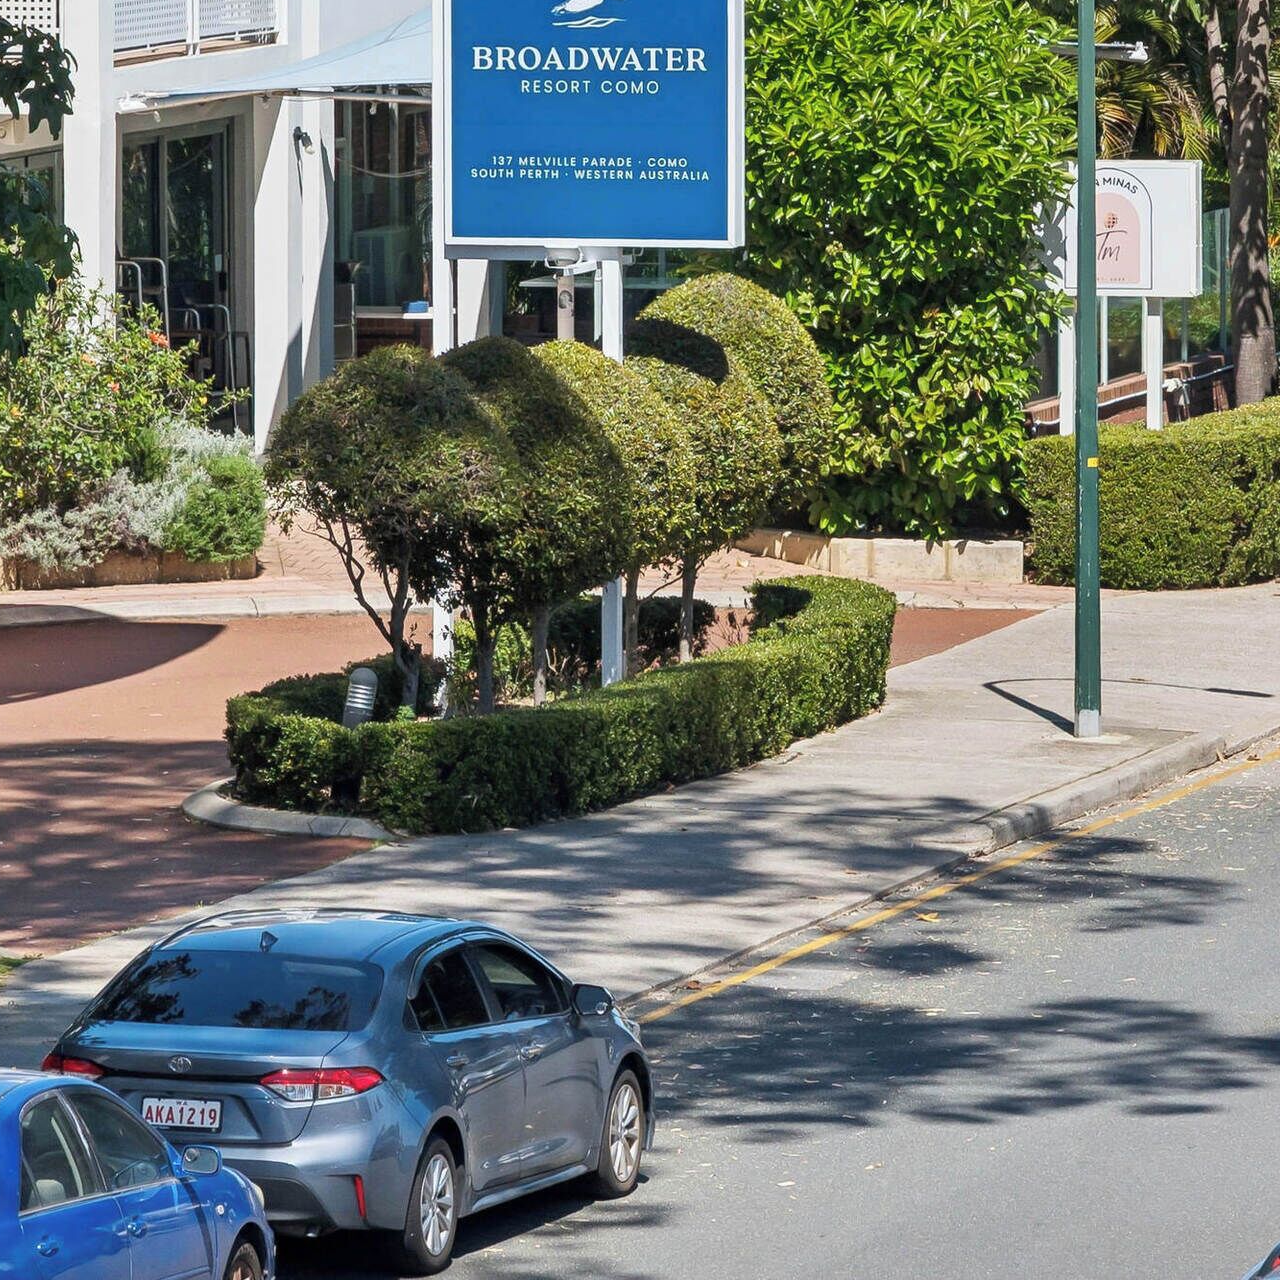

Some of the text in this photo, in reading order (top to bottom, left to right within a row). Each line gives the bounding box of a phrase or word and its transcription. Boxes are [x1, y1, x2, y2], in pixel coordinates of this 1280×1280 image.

[471, 45, 708, 72] BROADWATER
[521, 79, 659, 95] RESORT COMO
[491, 155, 688, 168] 137 MELVILLE PARADE COMO
[470, 168, 710, 181] SOUTH PERTH WESTERN AUSTRALIA
[1102, 177, 1138, 194] MINAS
[145, 1105, 217, 1126] AKA1219
